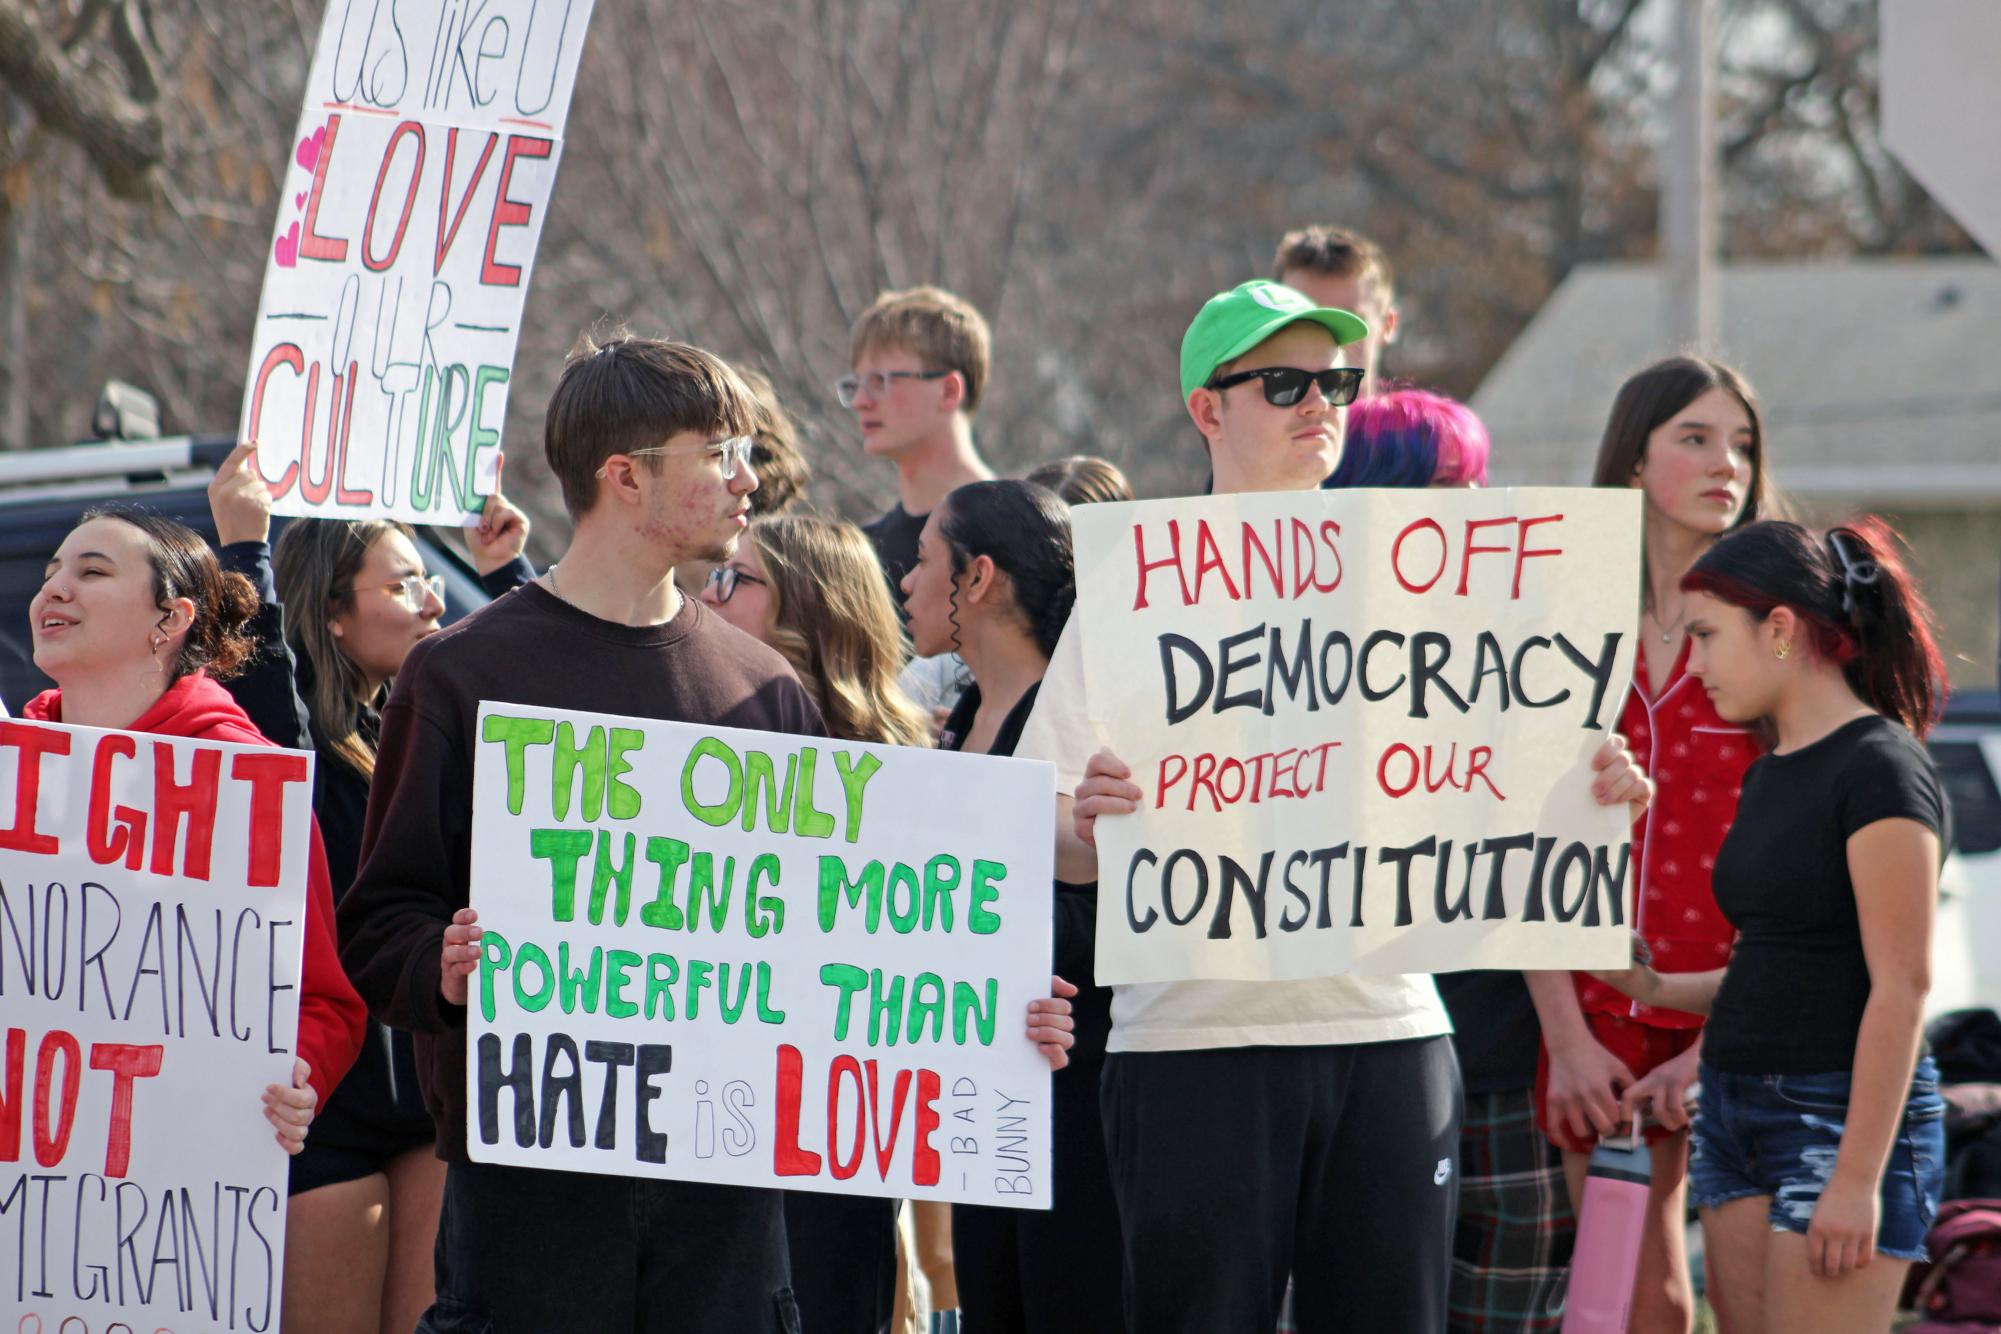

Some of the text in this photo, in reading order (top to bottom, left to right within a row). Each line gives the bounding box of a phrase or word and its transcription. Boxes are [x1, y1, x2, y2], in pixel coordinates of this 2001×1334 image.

[423, 0, 509, 111] like
[515, 0, 572, 117] U
[299, 114, 553, 286] LOVE
[248, 343, 510, 513] CULTURE
[1132, 514, 1564, 611] HANDS OFF
[1157, 617, 1624, 731] DEMOCRACY
[482, 714, 883, 844] THE ONLY
[1155, 741, 1506, 813] PROTECT OUR
[530, 828, 1008, 938] THING MORE
[1125, 832, 1631, 941] CONSTITUTION
[480, 930, 999, 1047] POWERFUL THAN
[477, 1032, 672, 1165] HATE
[773, 1043, 941, 1187] LOVE
[994, 1089, 1034, 1196] BUNNY
